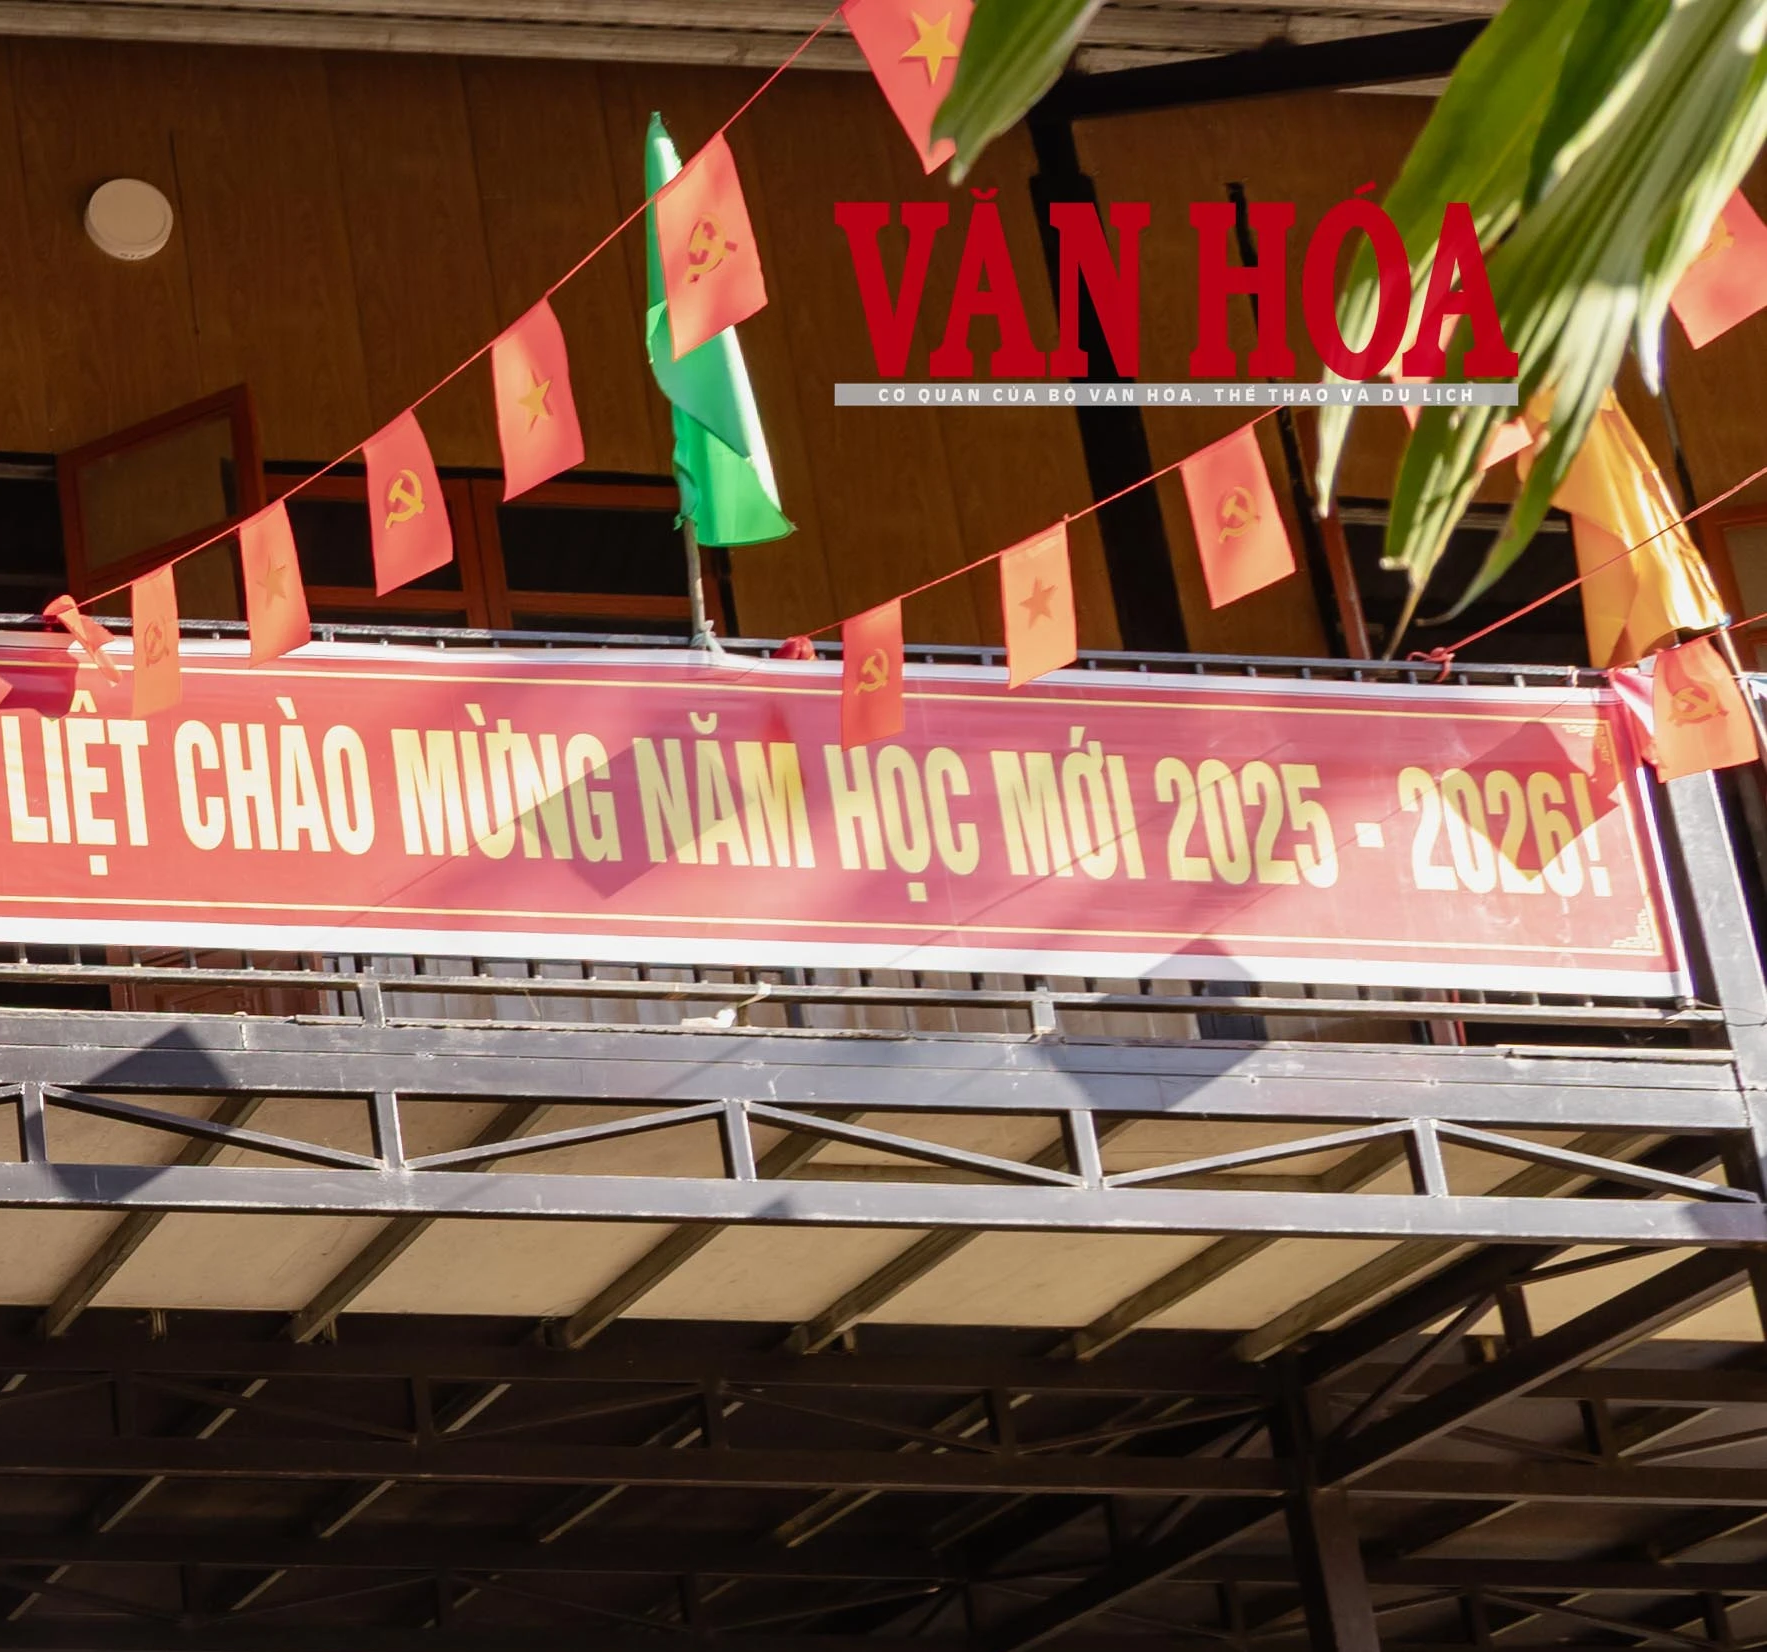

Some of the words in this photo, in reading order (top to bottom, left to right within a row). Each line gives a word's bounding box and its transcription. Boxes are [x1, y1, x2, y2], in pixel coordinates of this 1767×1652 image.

[0, 693, 153, 877] LIỆT
[173, 696, 377, 857] CHÀO
[389, 702, 621, 864] MỪNG
[632, 711, 816, 871] NĂM
[827, 744, 981, 903] HỌC
[989, 726, 1146, 882] MỚI
[1154, 757, 1339, 890] 2025
[1356, 823, 1383, 850] -
[1399, 766, 1613, 898] 2026!
